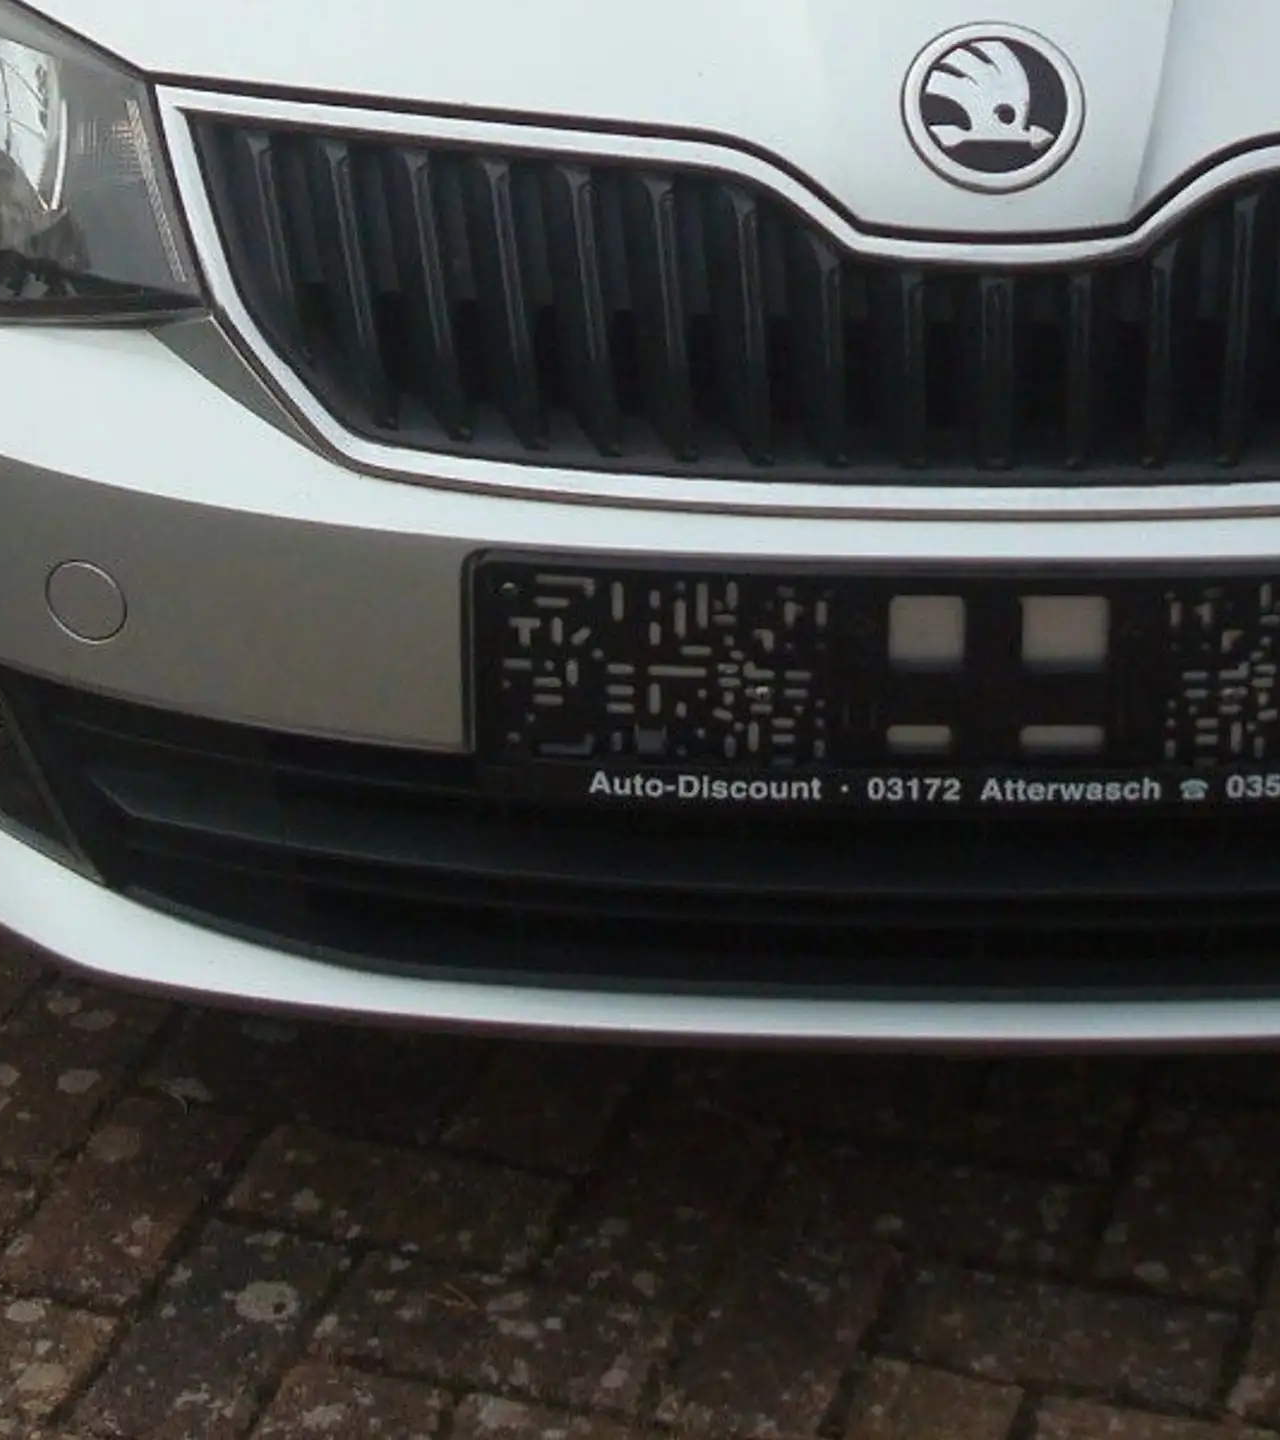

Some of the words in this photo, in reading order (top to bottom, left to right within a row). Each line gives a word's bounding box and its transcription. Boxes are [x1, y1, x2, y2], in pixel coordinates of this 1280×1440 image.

[588, 770, 822, 801] Auto-Discount
[866, 776, 962, 802] 03172
[979, 776, 1161, 802] Atterwasch
